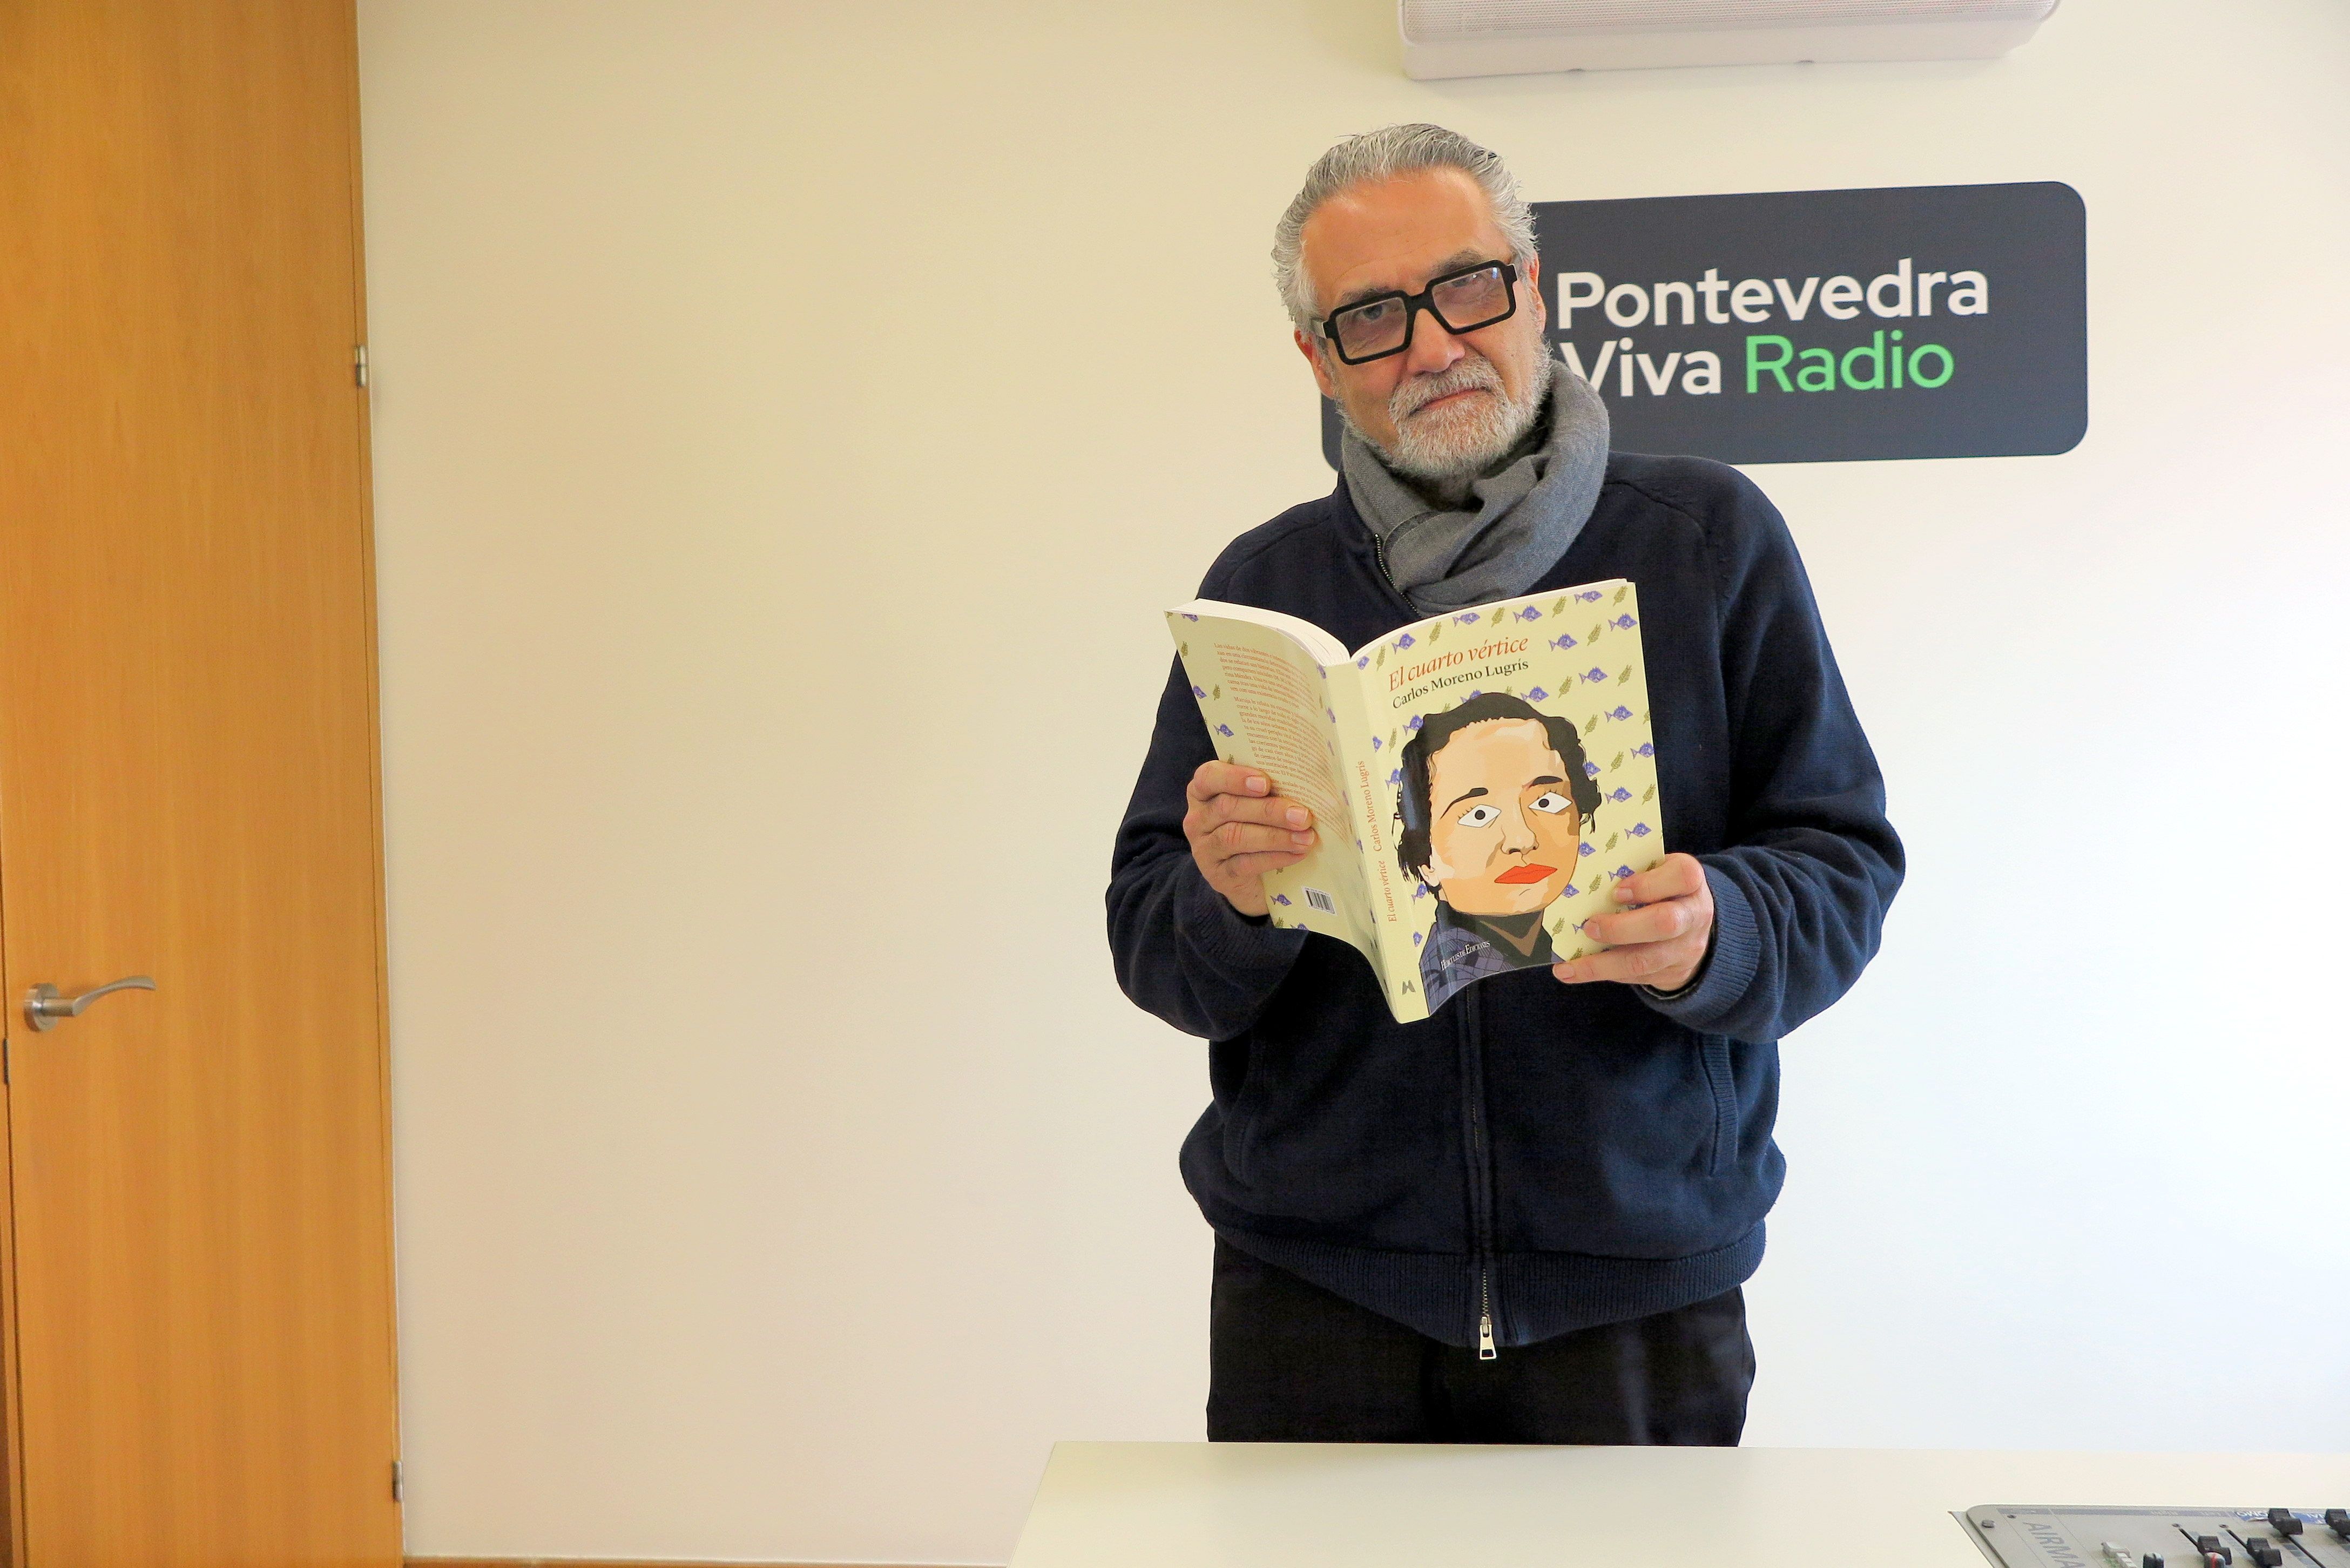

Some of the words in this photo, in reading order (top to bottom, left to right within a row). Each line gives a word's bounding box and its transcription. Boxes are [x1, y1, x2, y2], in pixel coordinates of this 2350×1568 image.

[1557, 257, 1988, 329] Pontevedra
[1559, 337, 1721, 397] Viva
[1746, 329, 1955, 394] Radio
[1389, 666, 1405, 693] El
[1407, 650, 1464, 682] cuarto
[1467, 636, 1529, 662] vértice
[1392, 685, 1429, 709] Carlos
[1430, 669, 1483, 692] Moreno
[1485, 658, 1529, 678] Lugrís
[1355, 760, 1370, 788] Lugrís
[1363, 789, 1377, 824] Moreno
[1370, 824, 1382, 851] Carlos
[1377, 860, 1389, 887] vértice
[1383, 887, 1395, 913] cuarto
[1387, 914, 1397, 922] El
